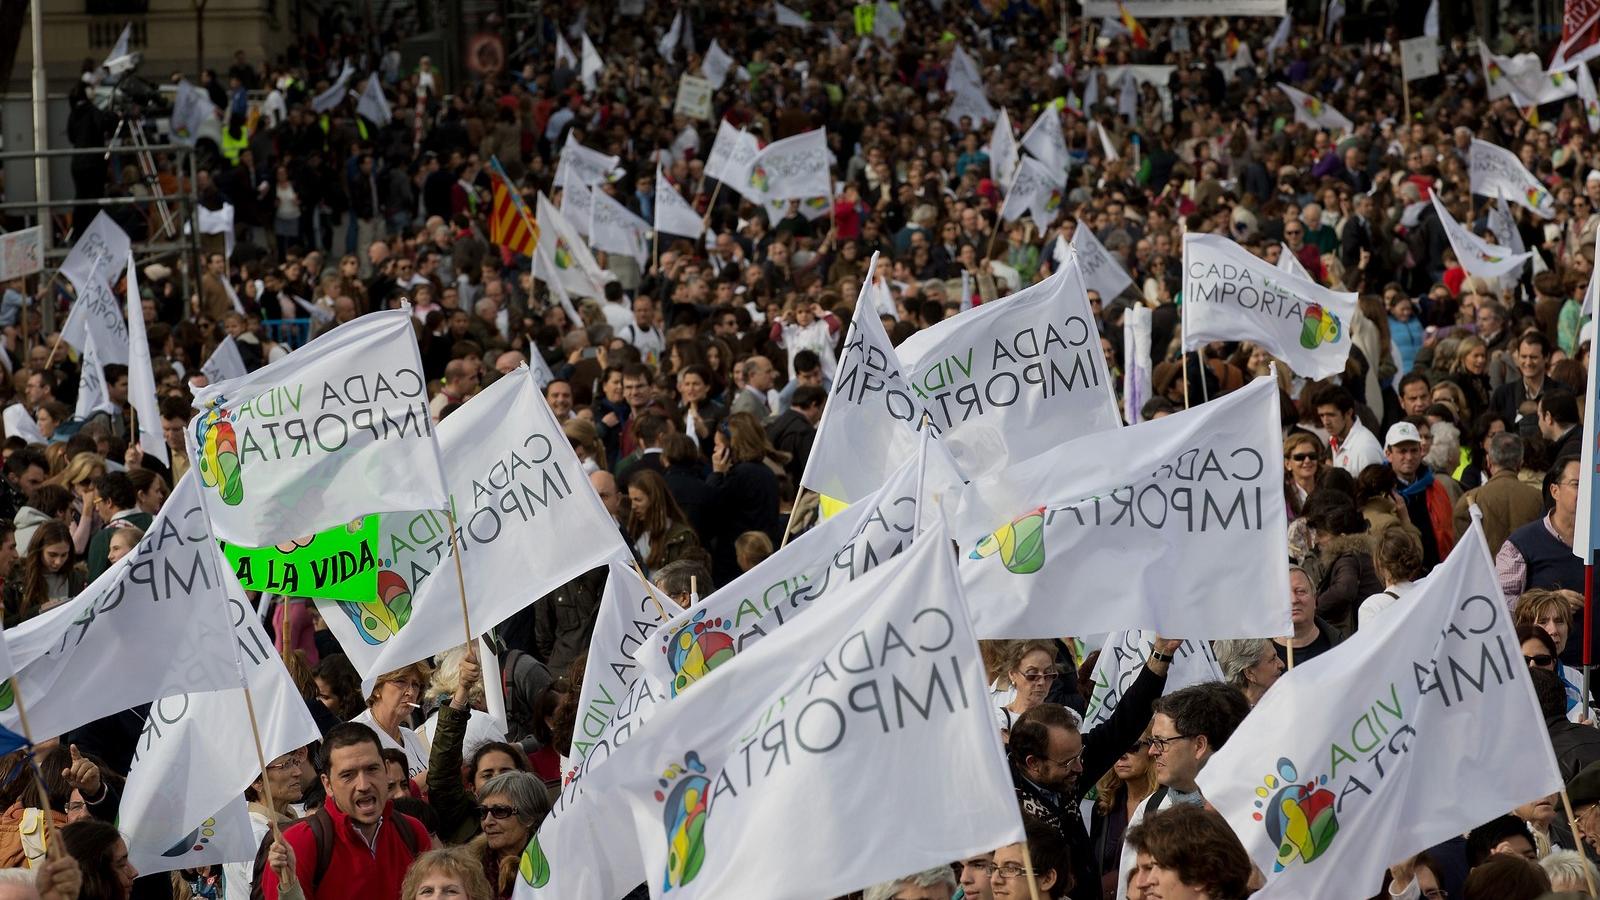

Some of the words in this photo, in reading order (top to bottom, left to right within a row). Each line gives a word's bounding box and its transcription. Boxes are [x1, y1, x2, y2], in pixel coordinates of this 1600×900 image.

[1189, 262, 1252, 285] CADA
[1190, 281, 1303, 324] IMPORTA
[266, 559, 299, 593] LA
[309, 539, 375, 590] VIDA
